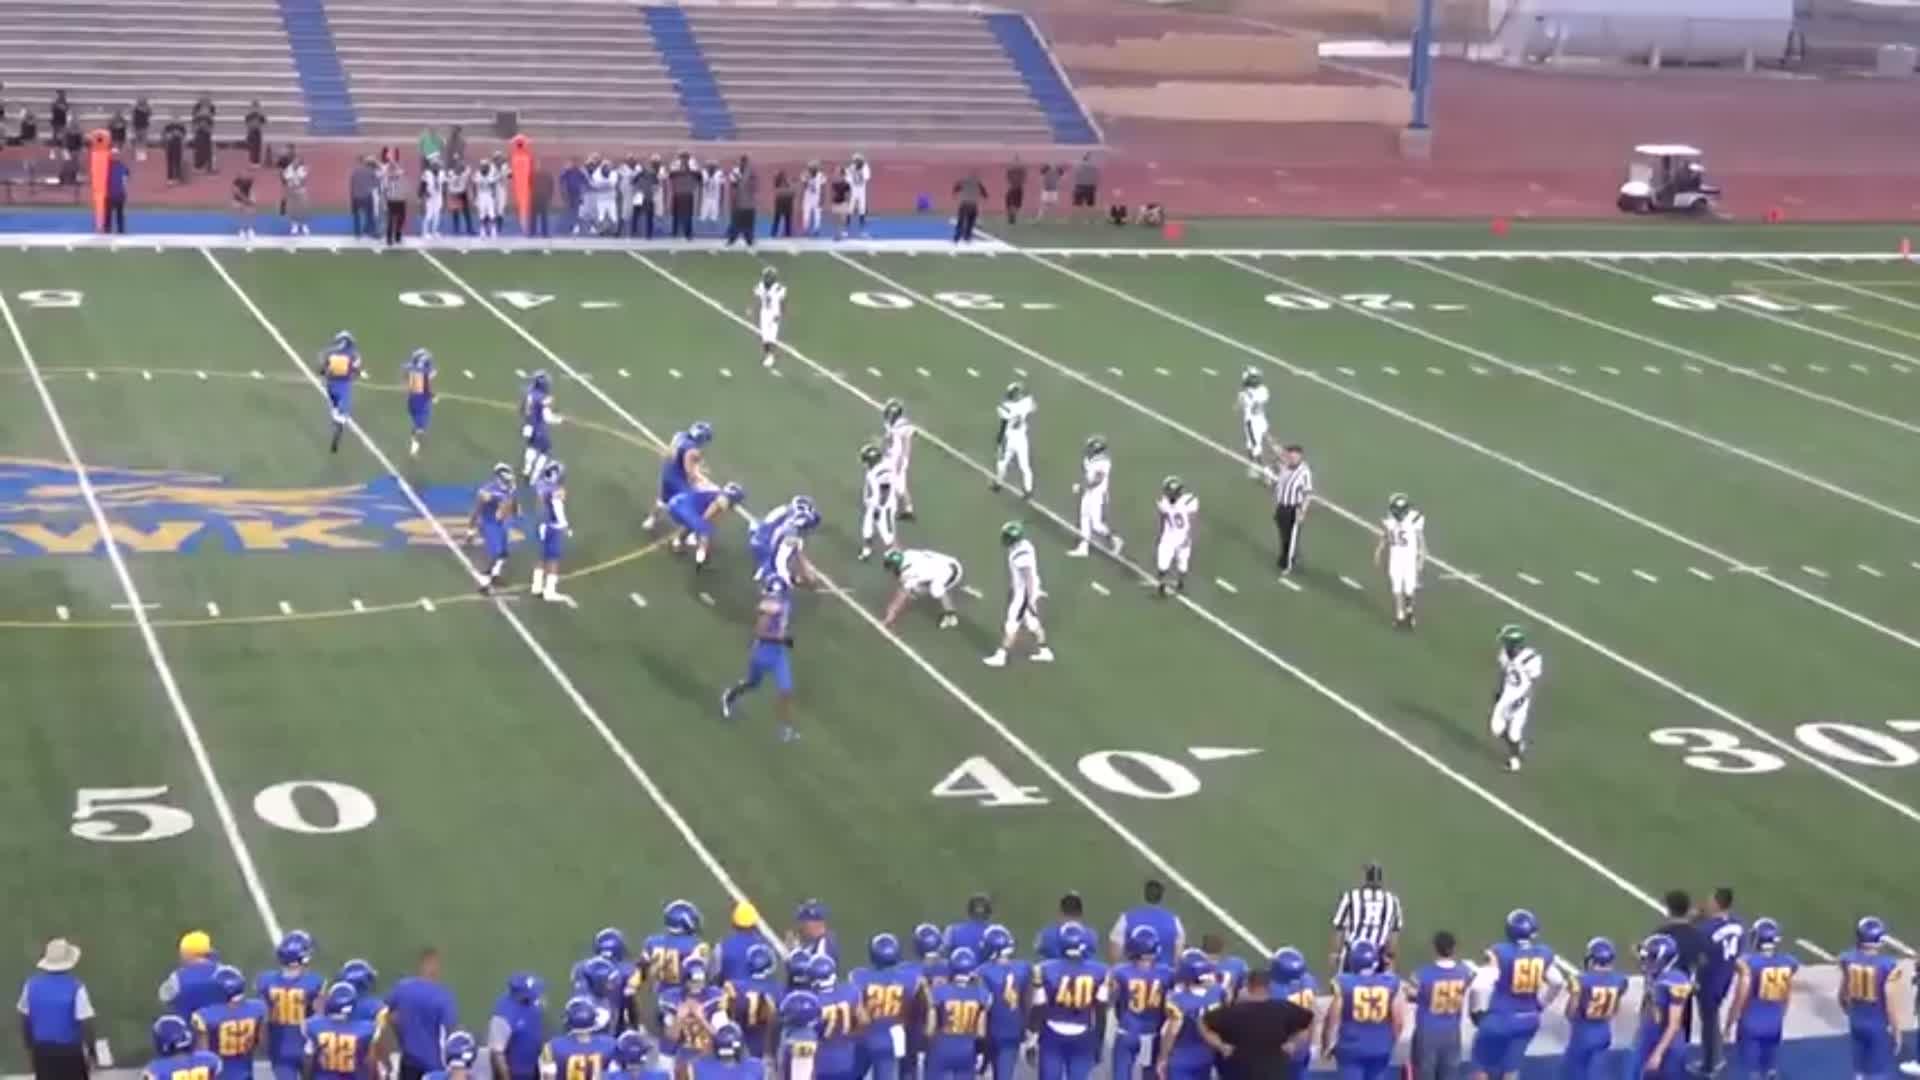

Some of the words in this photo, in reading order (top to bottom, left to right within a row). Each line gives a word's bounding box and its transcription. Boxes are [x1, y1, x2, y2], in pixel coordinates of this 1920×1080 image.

[1650, 722, 1919, 773] 30
[931, 750, 1201, 805] 40
[70, 780, 377, 841] 50
[1056, 976, 1093, 1009] 40
[1128, 979, 1162, 1014] 34
[1353, 986, 1390, 1022] 53
